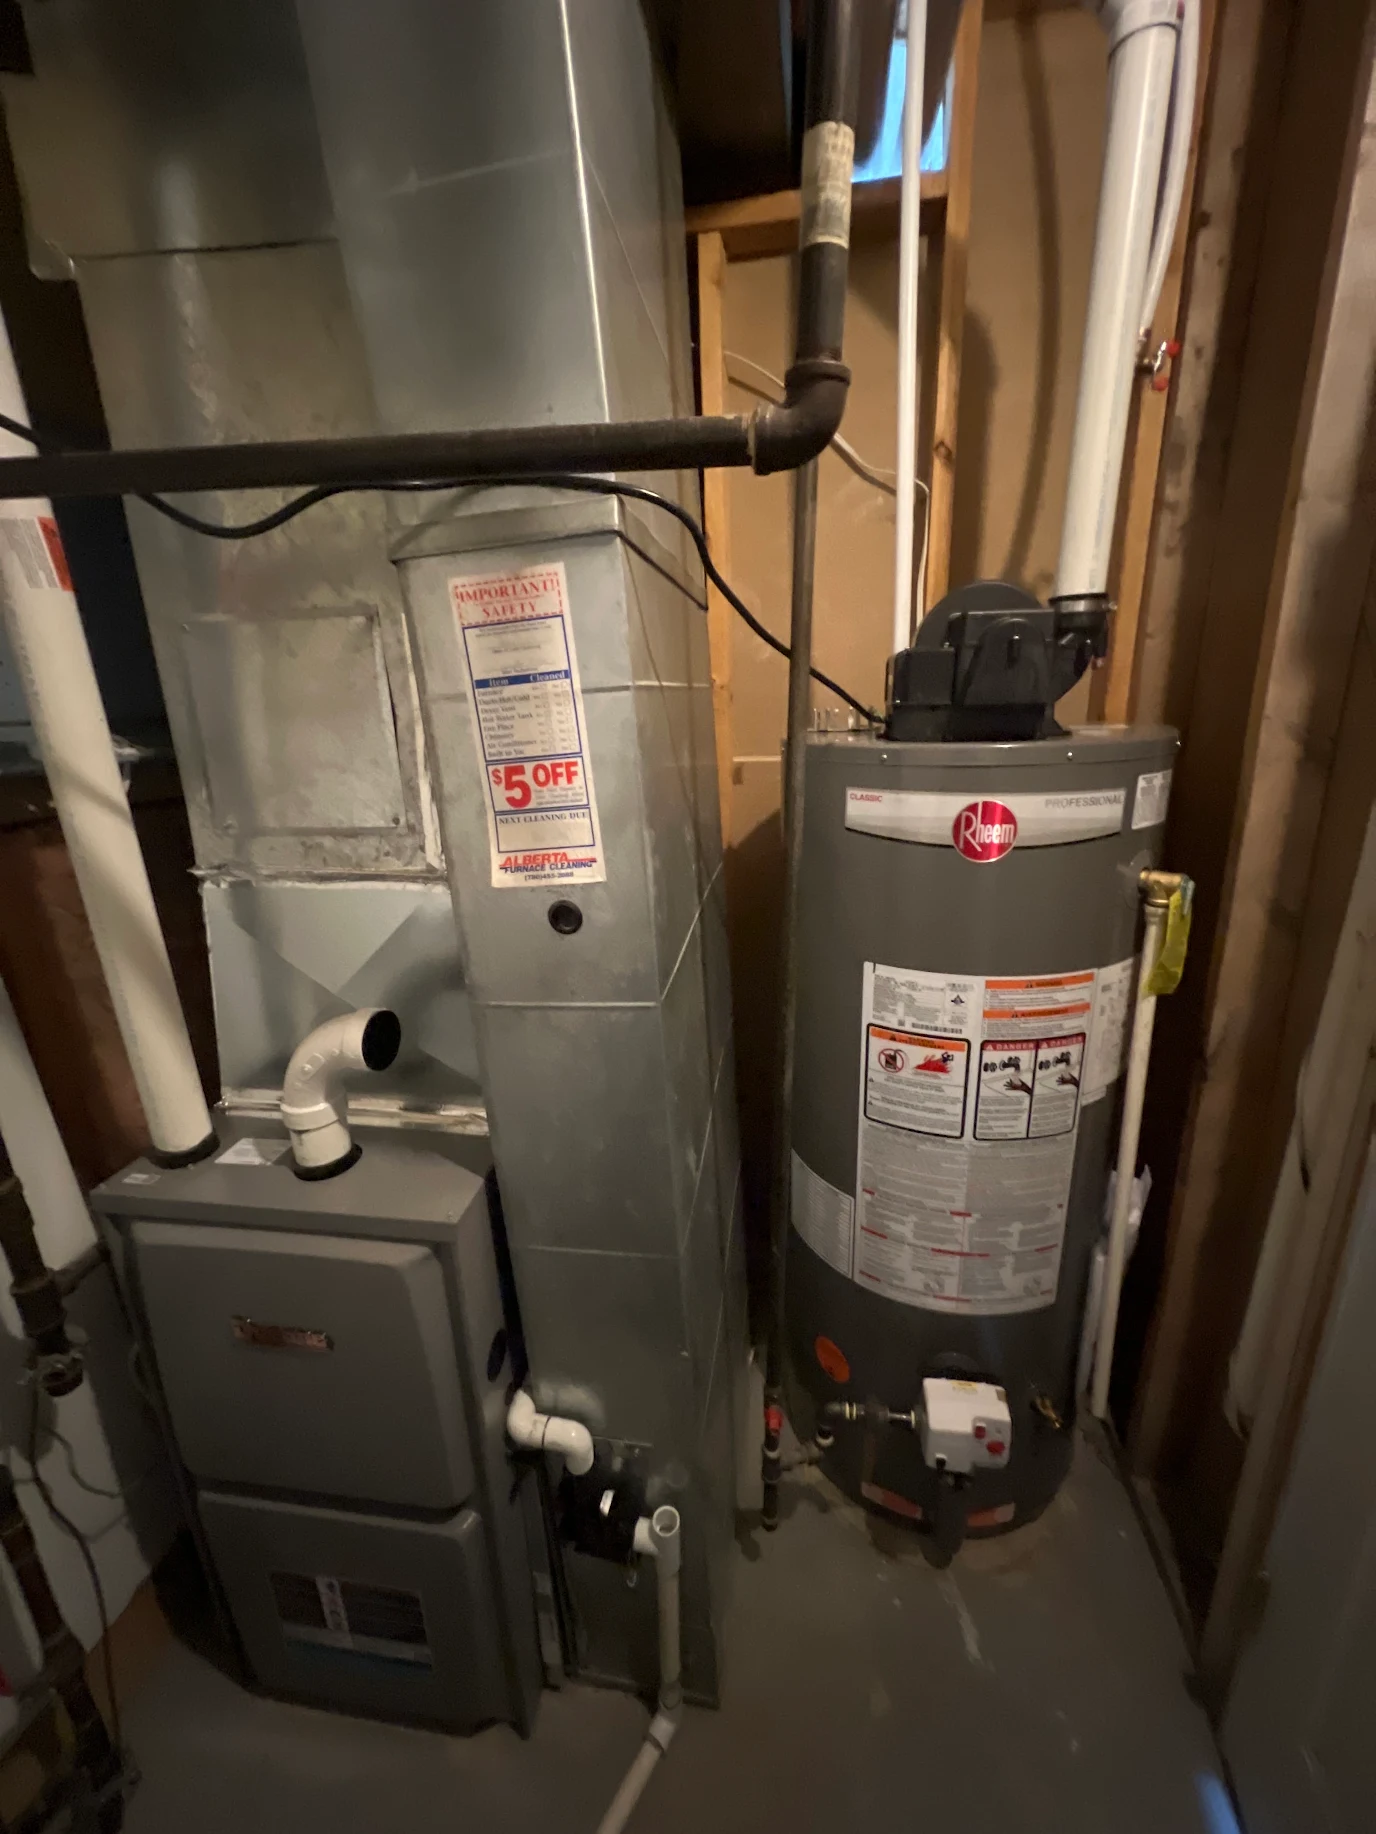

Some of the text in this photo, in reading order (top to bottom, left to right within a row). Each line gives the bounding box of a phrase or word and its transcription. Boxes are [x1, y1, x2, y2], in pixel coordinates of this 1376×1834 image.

[482, 601, 537, 618] SAFETY
[490, 672, 565, 687] Item Cleaned
[532, 761, 578, 787] OFF
[850, 793, 883, 803] CLASSIC
[1045, 794, 1124, 809] PROFESSIONAL
[500, 815, 520, 825] NEXT
[522, 813, 567, 823] CLEANING
[959, 801, 1015, 852] Rheem
[500, 852, 569, 867] ALBERTA
[504, 860, 592, 873] FURNACE CLEANING
[996, 1042, 1034, 1050] DANGER
